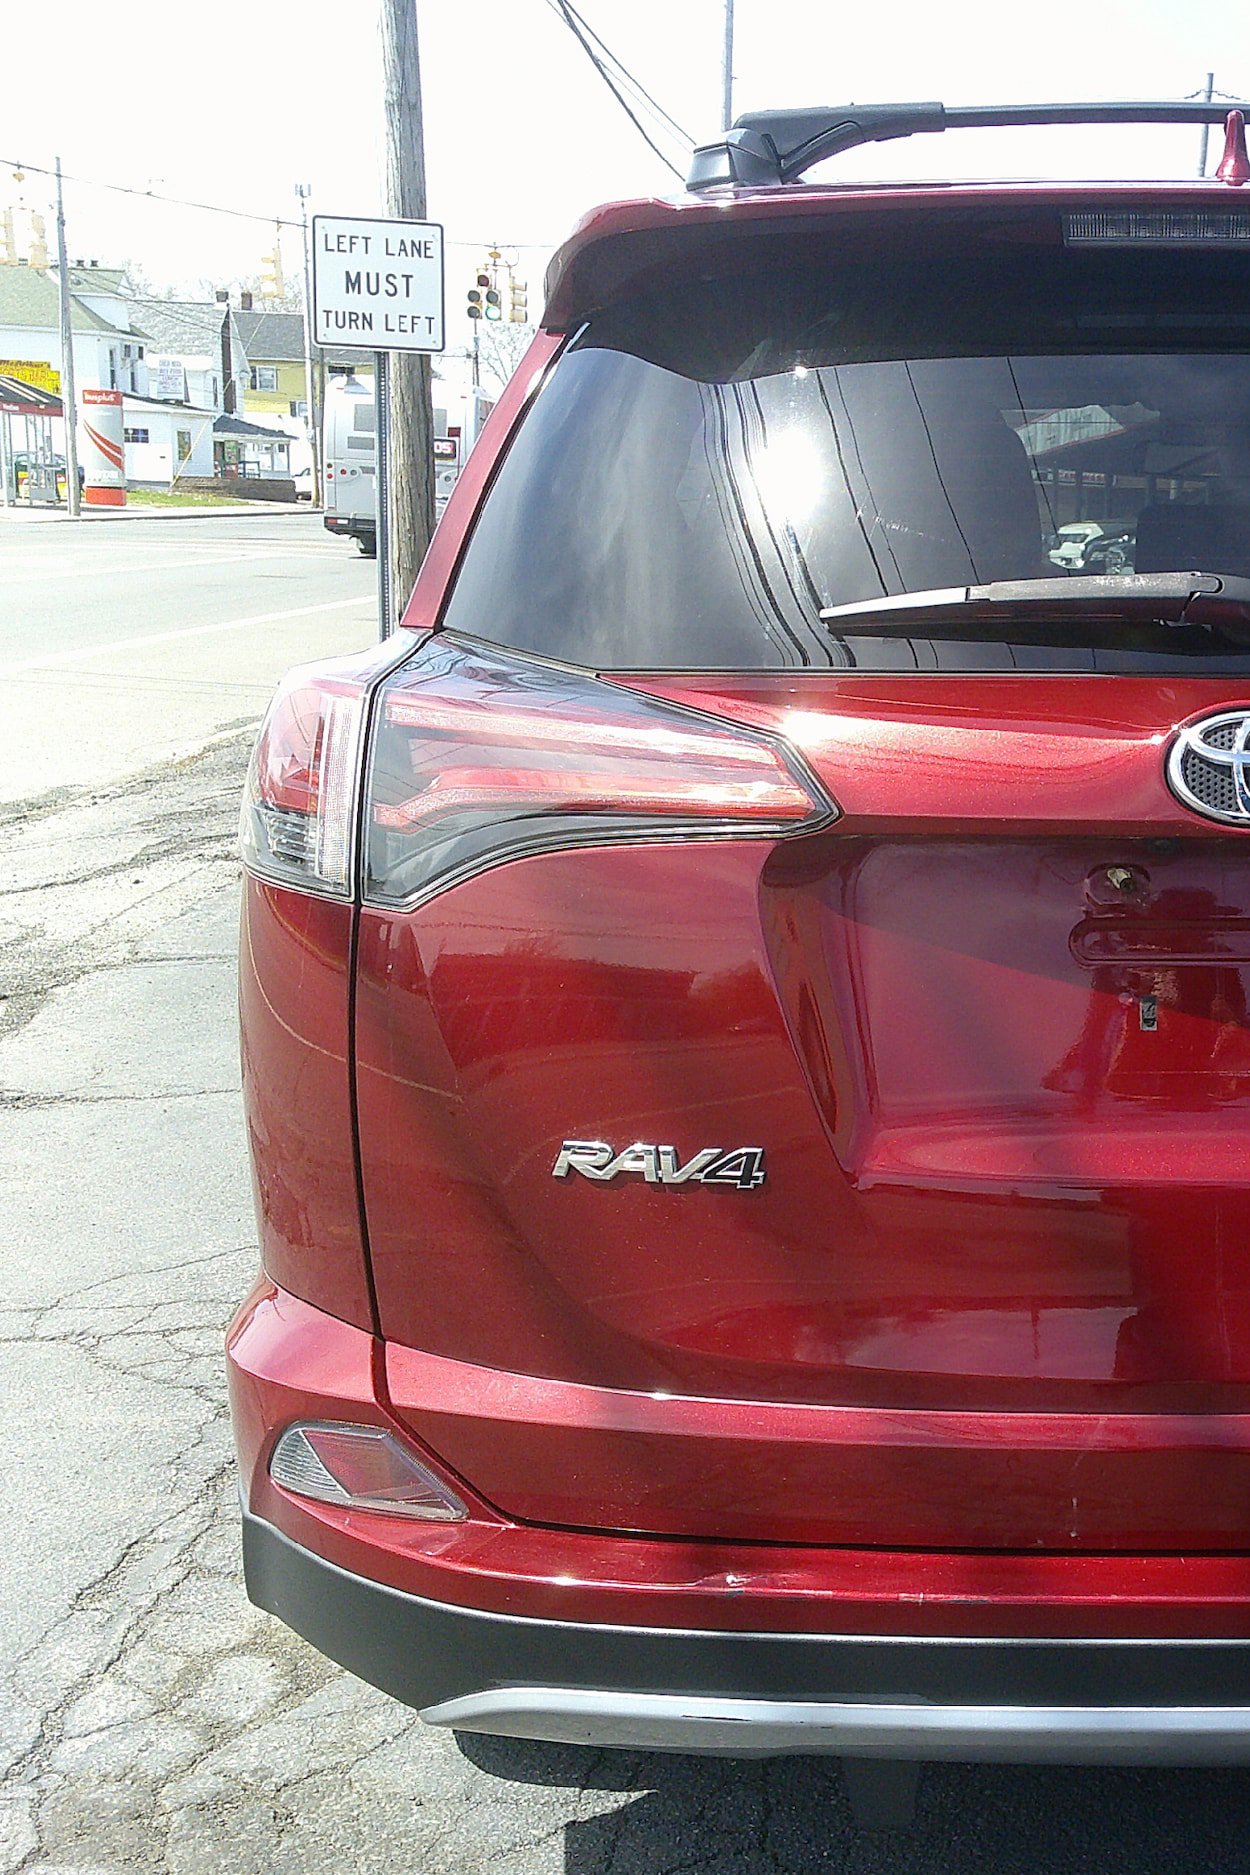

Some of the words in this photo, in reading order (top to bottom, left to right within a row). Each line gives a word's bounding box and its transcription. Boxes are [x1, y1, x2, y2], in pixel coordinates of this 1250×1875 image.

[324, 233, 372, 255] LEFT
[385, 238, 434, 259] LANE
[345, 270, 414, 298] MUST
[322, 309, 374, 331] TURN
[385, 313, 435, 335] LEFT
[551, 1140, 764, 1189] RAV4
